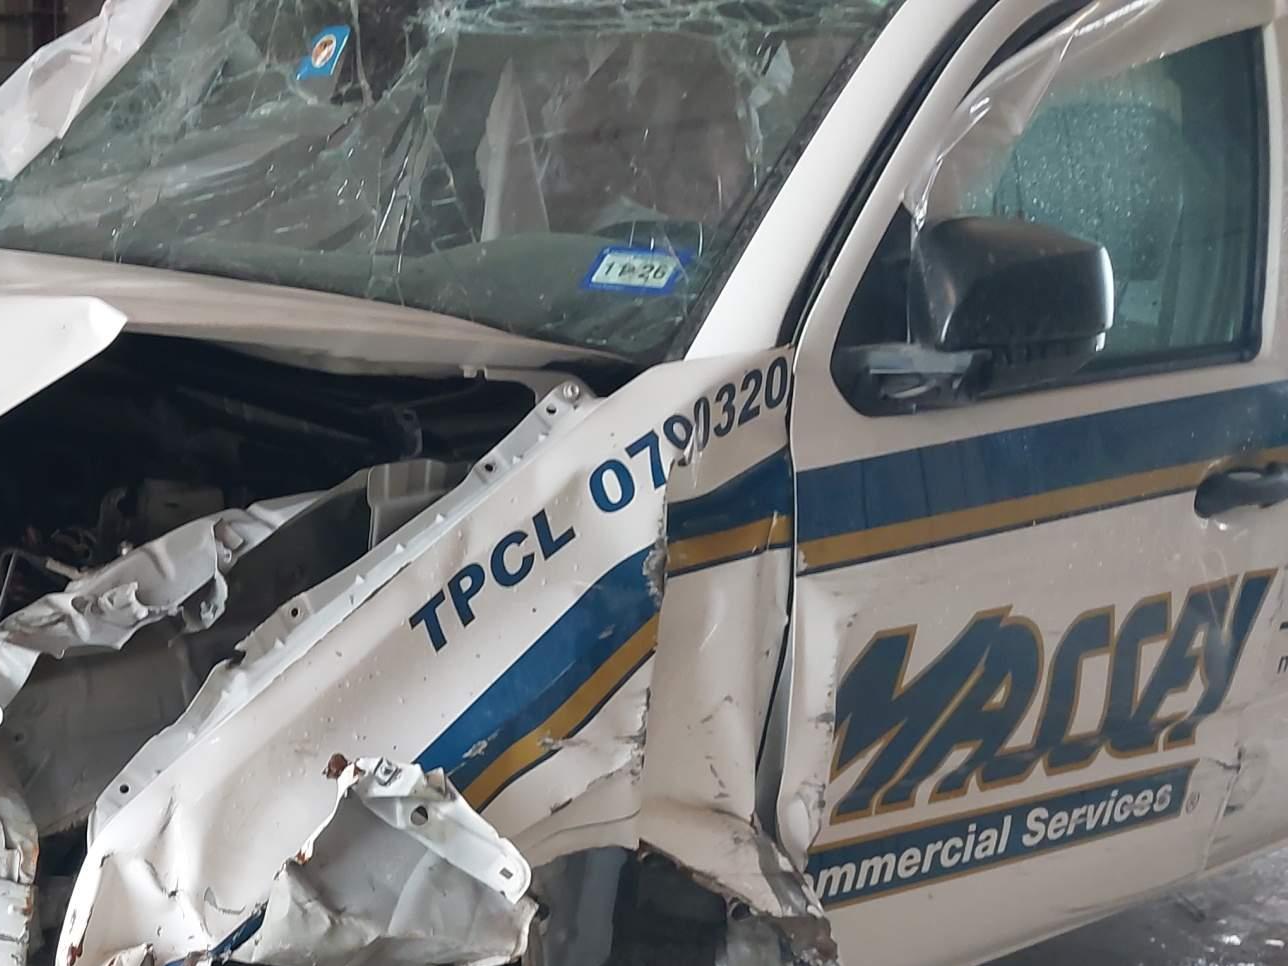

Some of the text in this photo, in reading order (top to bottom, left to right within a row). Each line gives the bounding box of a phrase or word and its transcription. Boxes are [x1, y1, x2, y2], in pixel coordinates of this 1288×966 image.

[409, 357, 788, 652] TPCL 0790320
[830, 567, 1278, 824] MACCEY
[1022, 783, 1172, 847] Services
